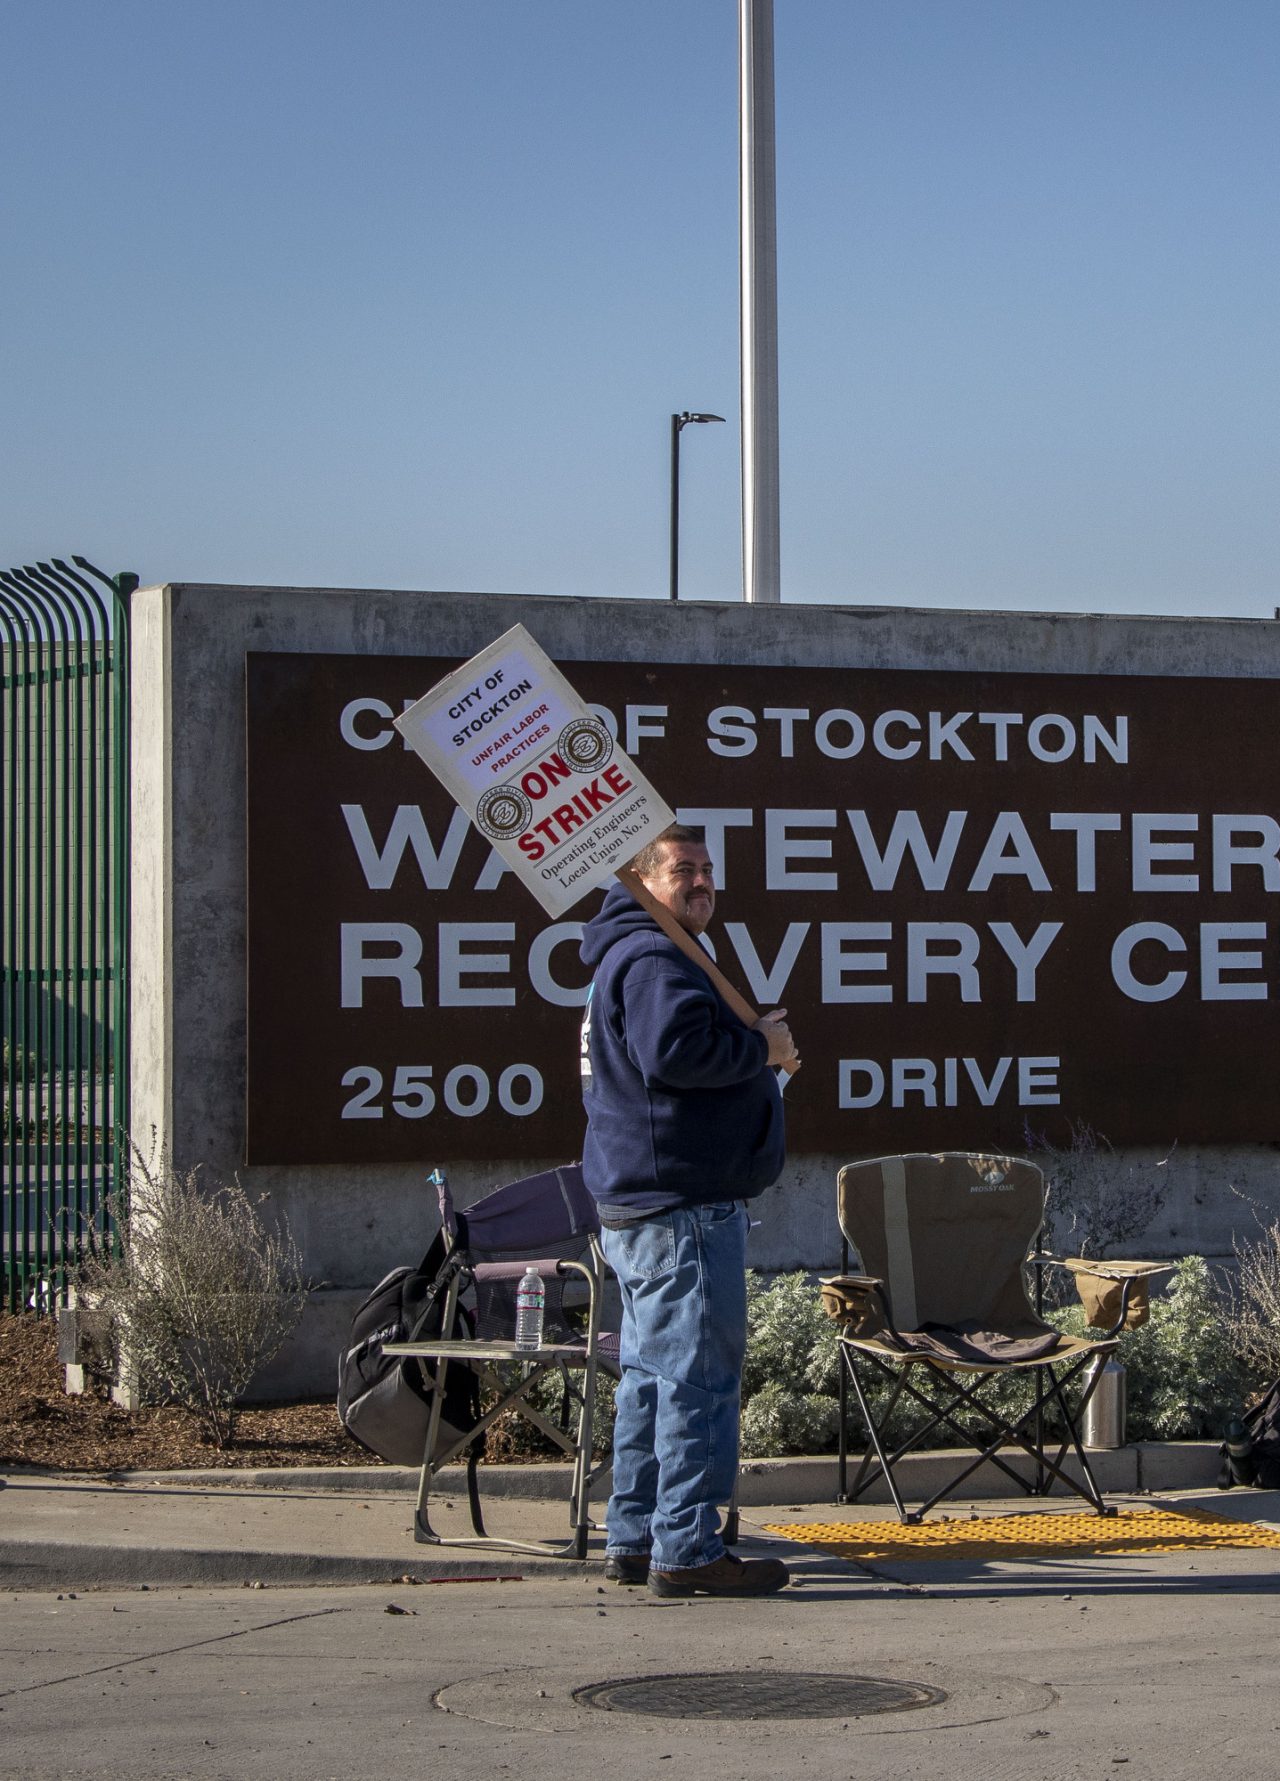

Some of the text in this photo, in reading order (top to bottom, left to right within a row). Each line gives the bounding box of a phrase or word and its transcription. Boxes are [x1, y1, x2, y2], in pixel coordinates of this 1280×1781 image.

[448, 669, 505, 720] CITY OF
[452, 679, 533, 747] STOCKTON
[471, 703, 550, 767] UNFAIR LABOR
[491, 724, 551, 773] PRACTICES
[707, 706, 1128, 765] STOCKTON
[521, 752, 572, 801] ON
[517, 763, 633, 861] STRIKE
[541, 795, 648, 881] Operating Engineers
[559, 814, 650, 888] Local Union No. 3
[341, 921, 1064, 1008] RECVERY
[341, 1063, 544, 1120] 2500
[838, 1056, 1061, 1109] DRIVE
